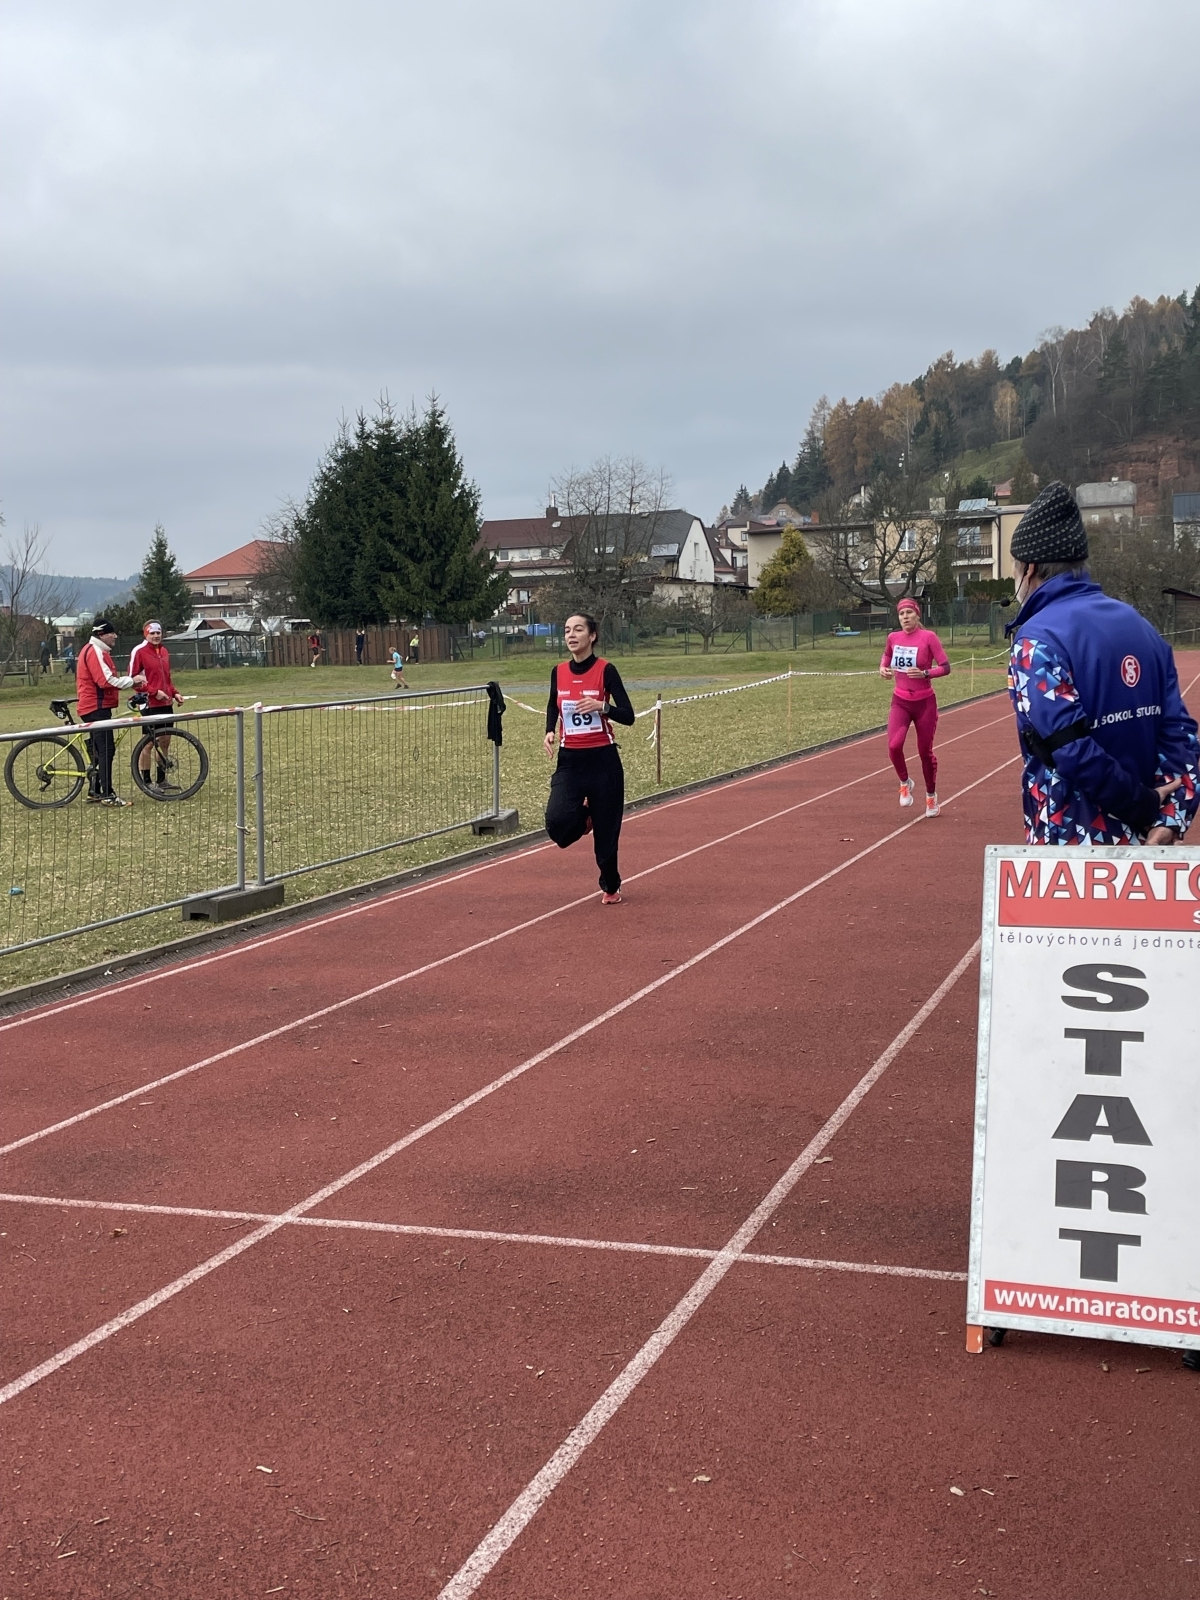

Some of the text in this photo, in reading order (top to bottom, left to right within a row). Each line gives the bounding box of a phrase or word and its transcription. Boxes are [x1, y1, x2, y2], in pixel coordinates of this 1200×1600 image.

[894, 656, 913, 667] 183
[572, 713, 592, 726] 69
[1101, 710, 1133, 725] SOKOL
[1000, 931, 1122, 948] tělovýchovná
[1051, 963, 1153, 1283] START
[994, 1288, 1200, 1327] www.maratonst
